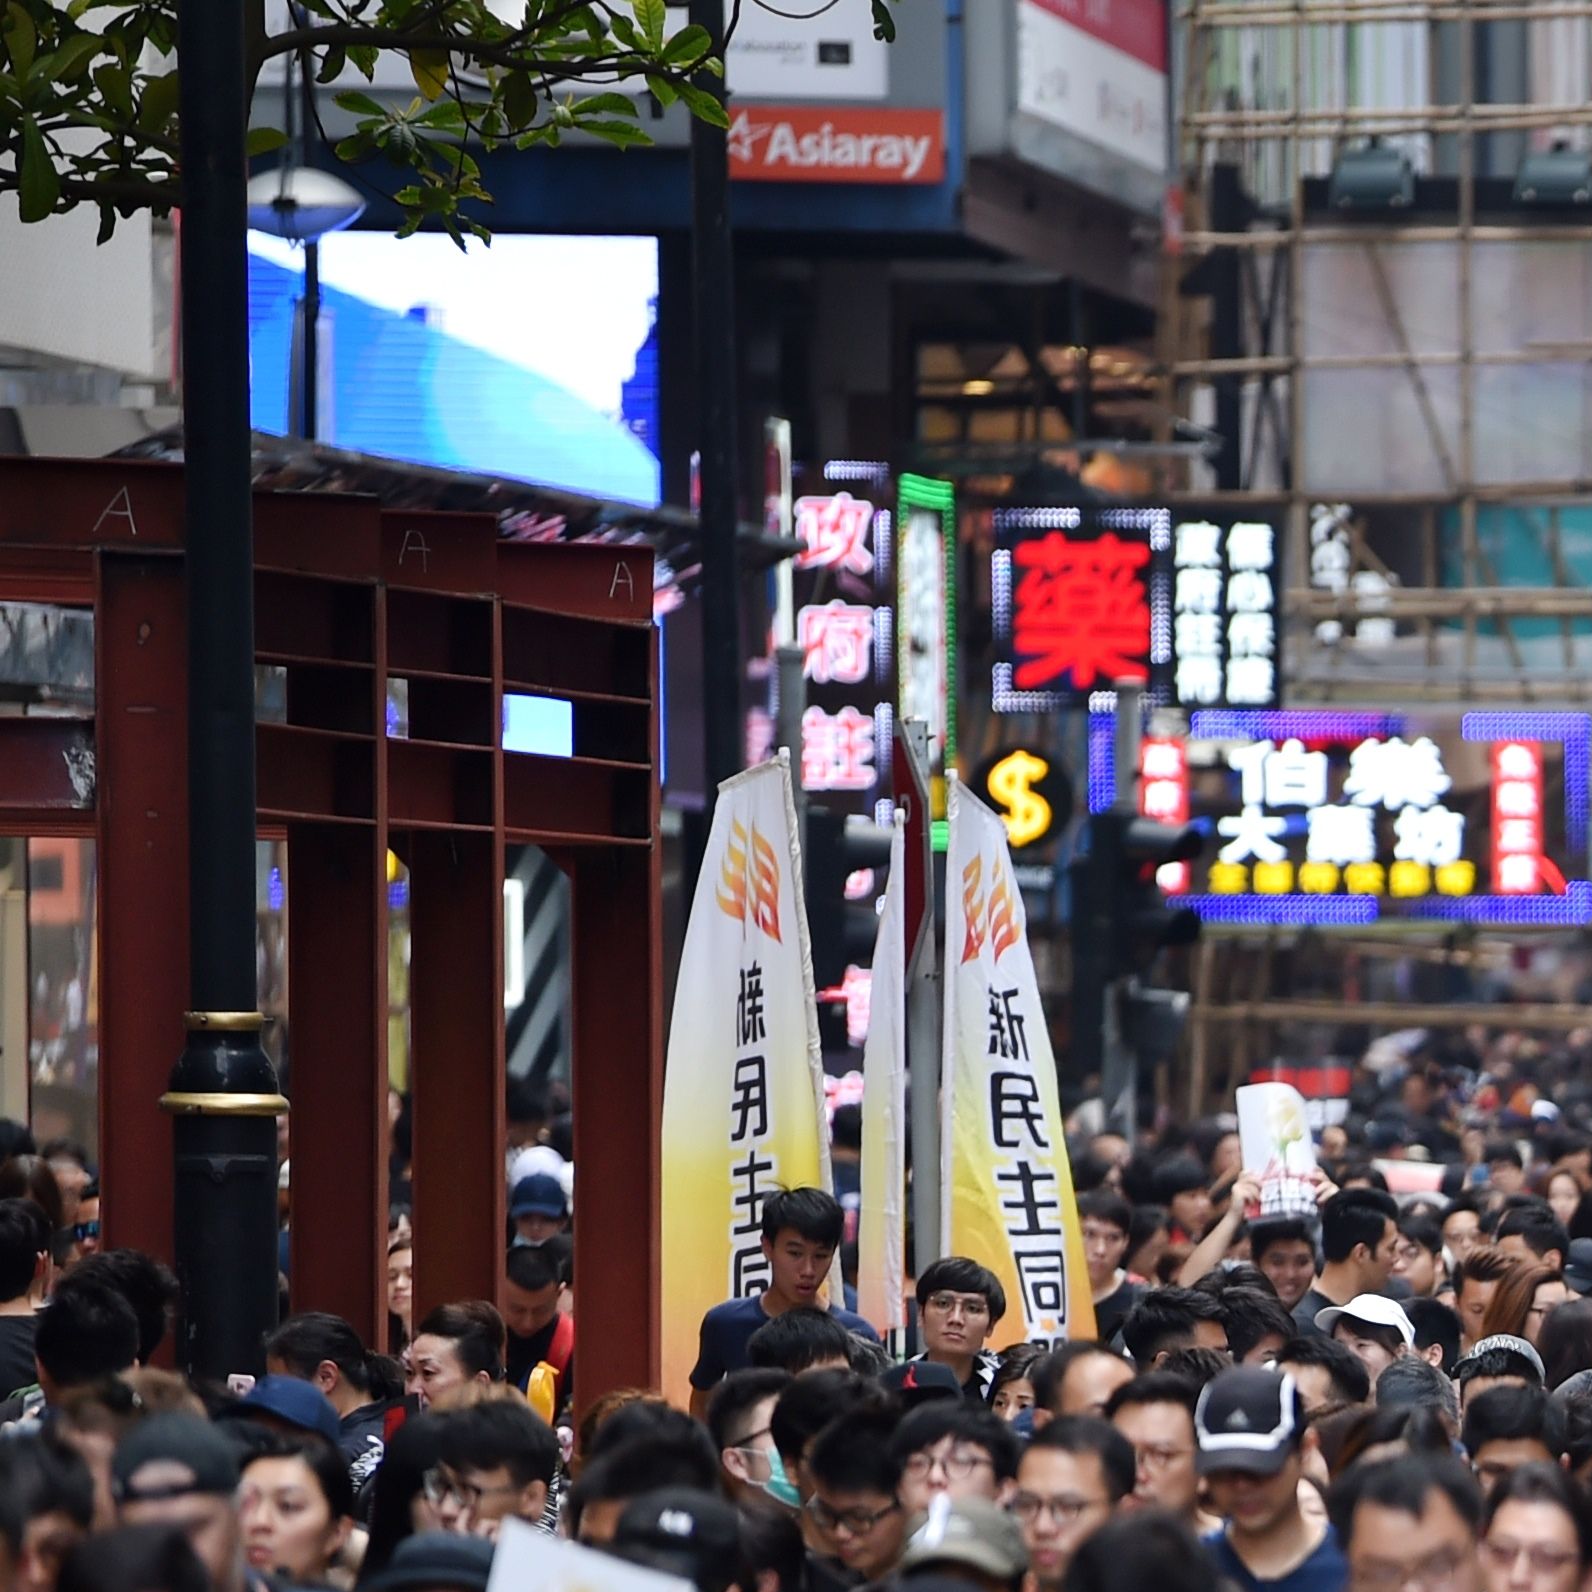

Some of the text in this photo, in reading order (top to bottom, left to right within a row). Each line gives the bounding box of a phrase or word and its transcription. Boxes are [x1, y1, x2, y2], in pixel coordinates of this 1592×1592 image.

[765, 122, 931, 178] Asiaray
[93, 486, 136, 535] A
[399, 530, 431, 573] A
[609, 562, 633, 602] A
[988, 983, 1067, 1350] 新民主同
